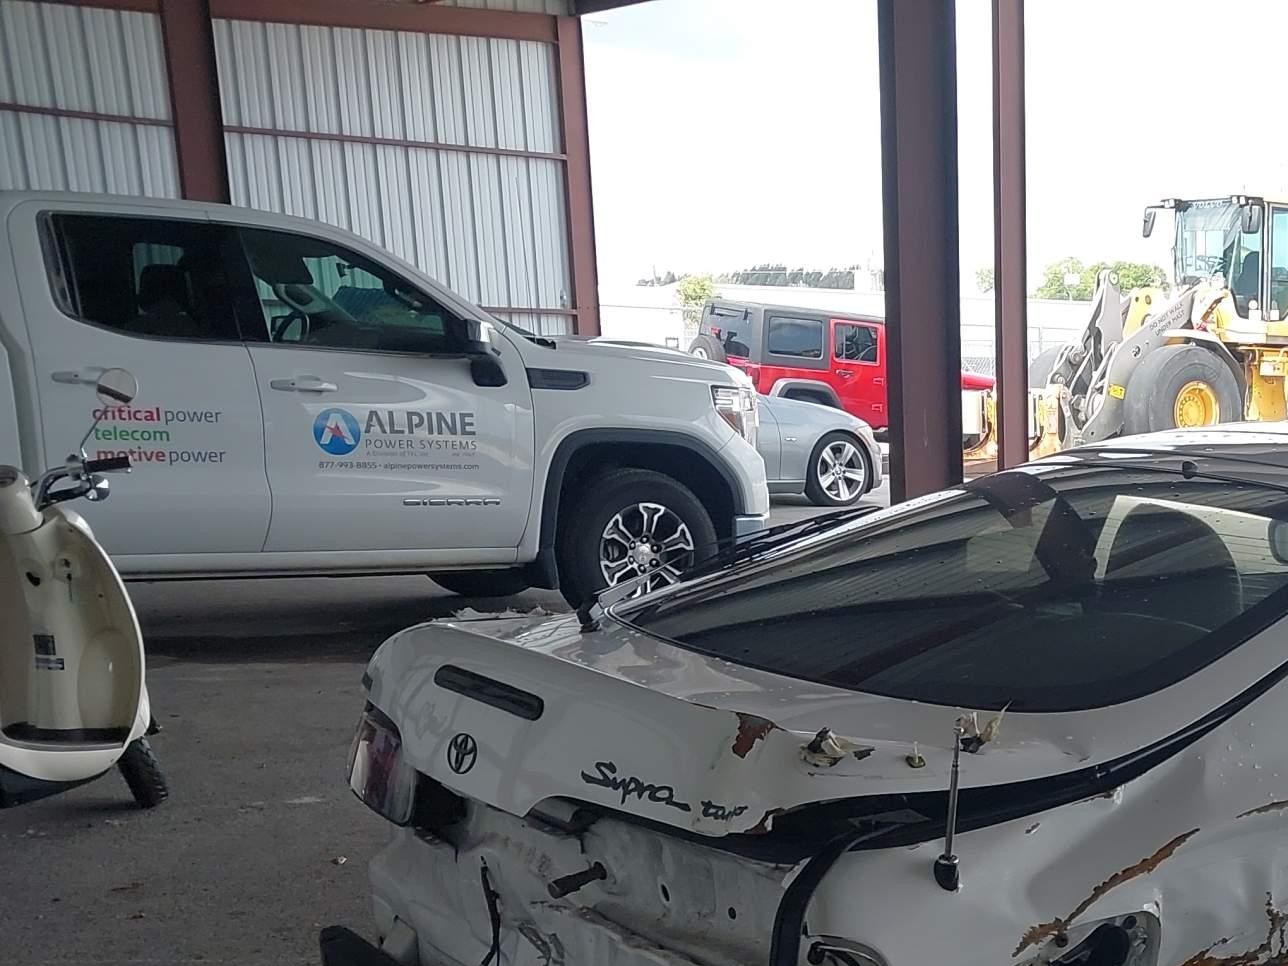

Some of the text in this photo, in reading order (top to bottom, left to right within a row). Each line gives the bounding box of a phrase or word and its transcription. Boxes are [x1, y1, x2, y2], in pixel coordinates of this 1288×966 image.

[92, 407, 221, 425] critical power
[364, 410, 477, 436] ALPINE
[95, 426, 170, 441] telecom
[365, 439, 477, 450] POWER SYSTEMS
[96, 446, 226, 466] motive power
[383, 462, 480, 471] alpinepowersystems.com
[580, 761, 692, 812] Supra
